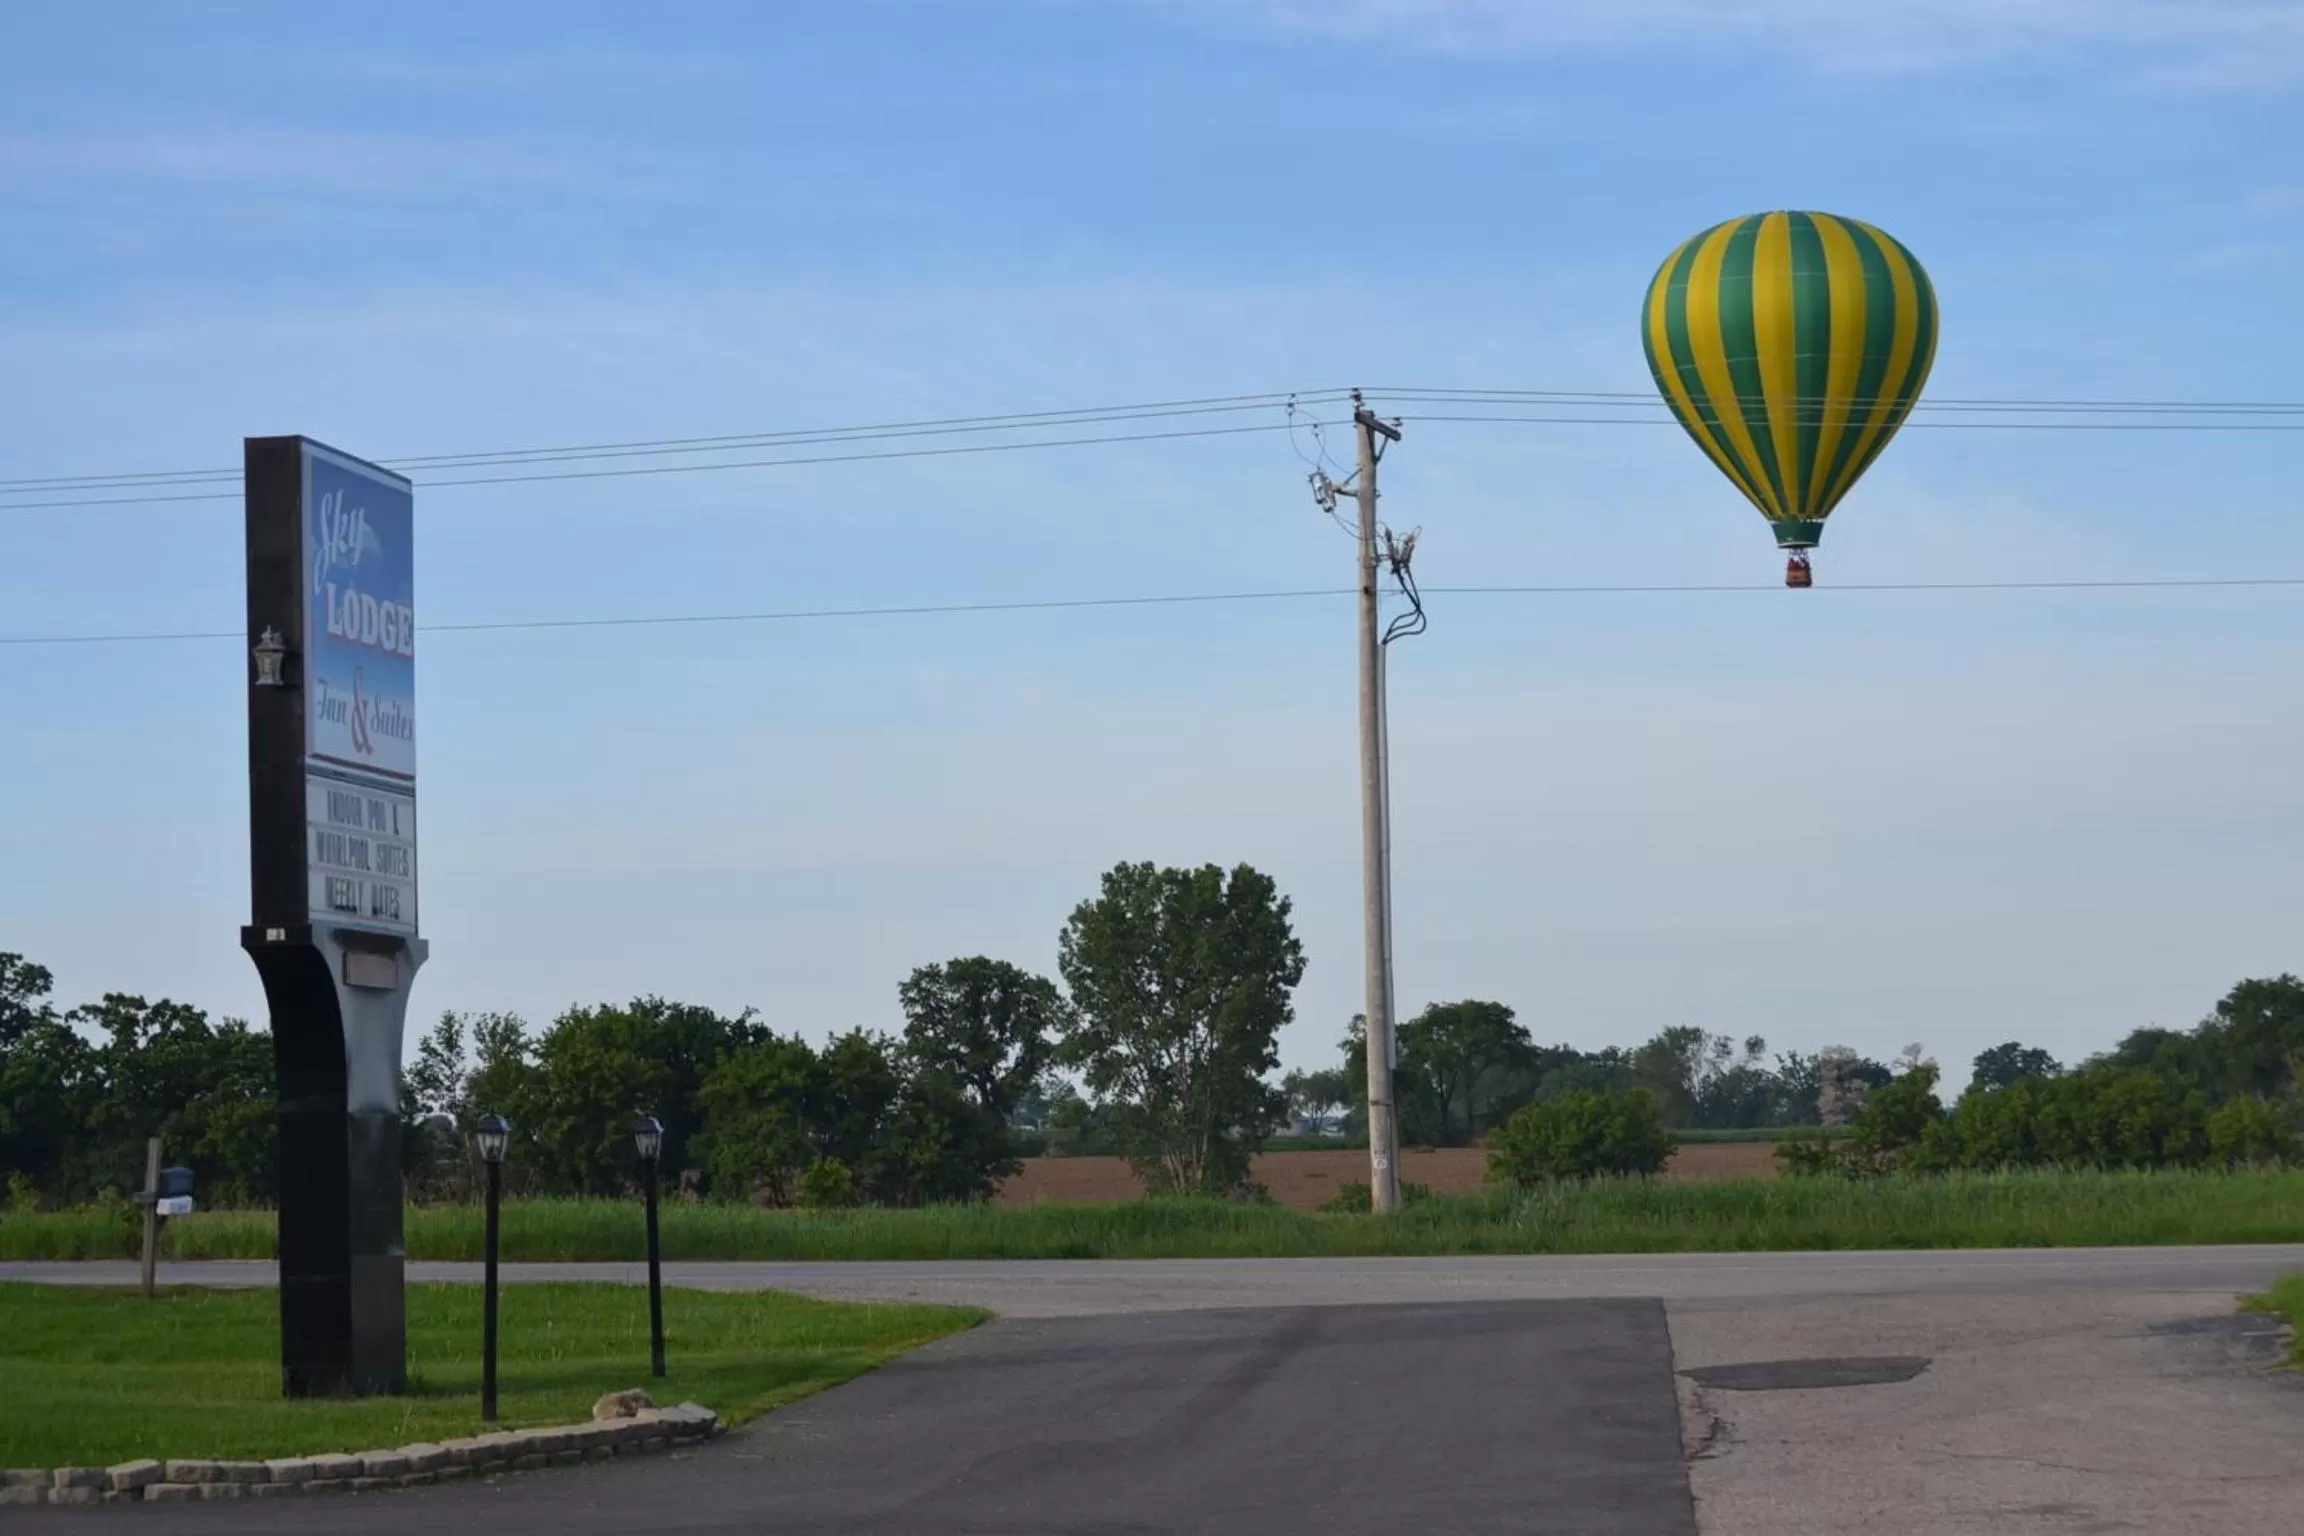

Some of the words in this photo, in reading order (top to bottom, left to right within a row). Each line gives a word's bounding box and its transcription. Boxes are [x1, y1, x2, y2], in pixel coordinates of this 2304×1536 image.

[314, 488, 366, 595] Sky
[326, 581, 414, 658] LODGE
[316, 676, 348, 725] Inn
[351, 664, 373, 755] &
[370, 692, 415, 742] Suites
[375, 842, 410, 878] SUITES
